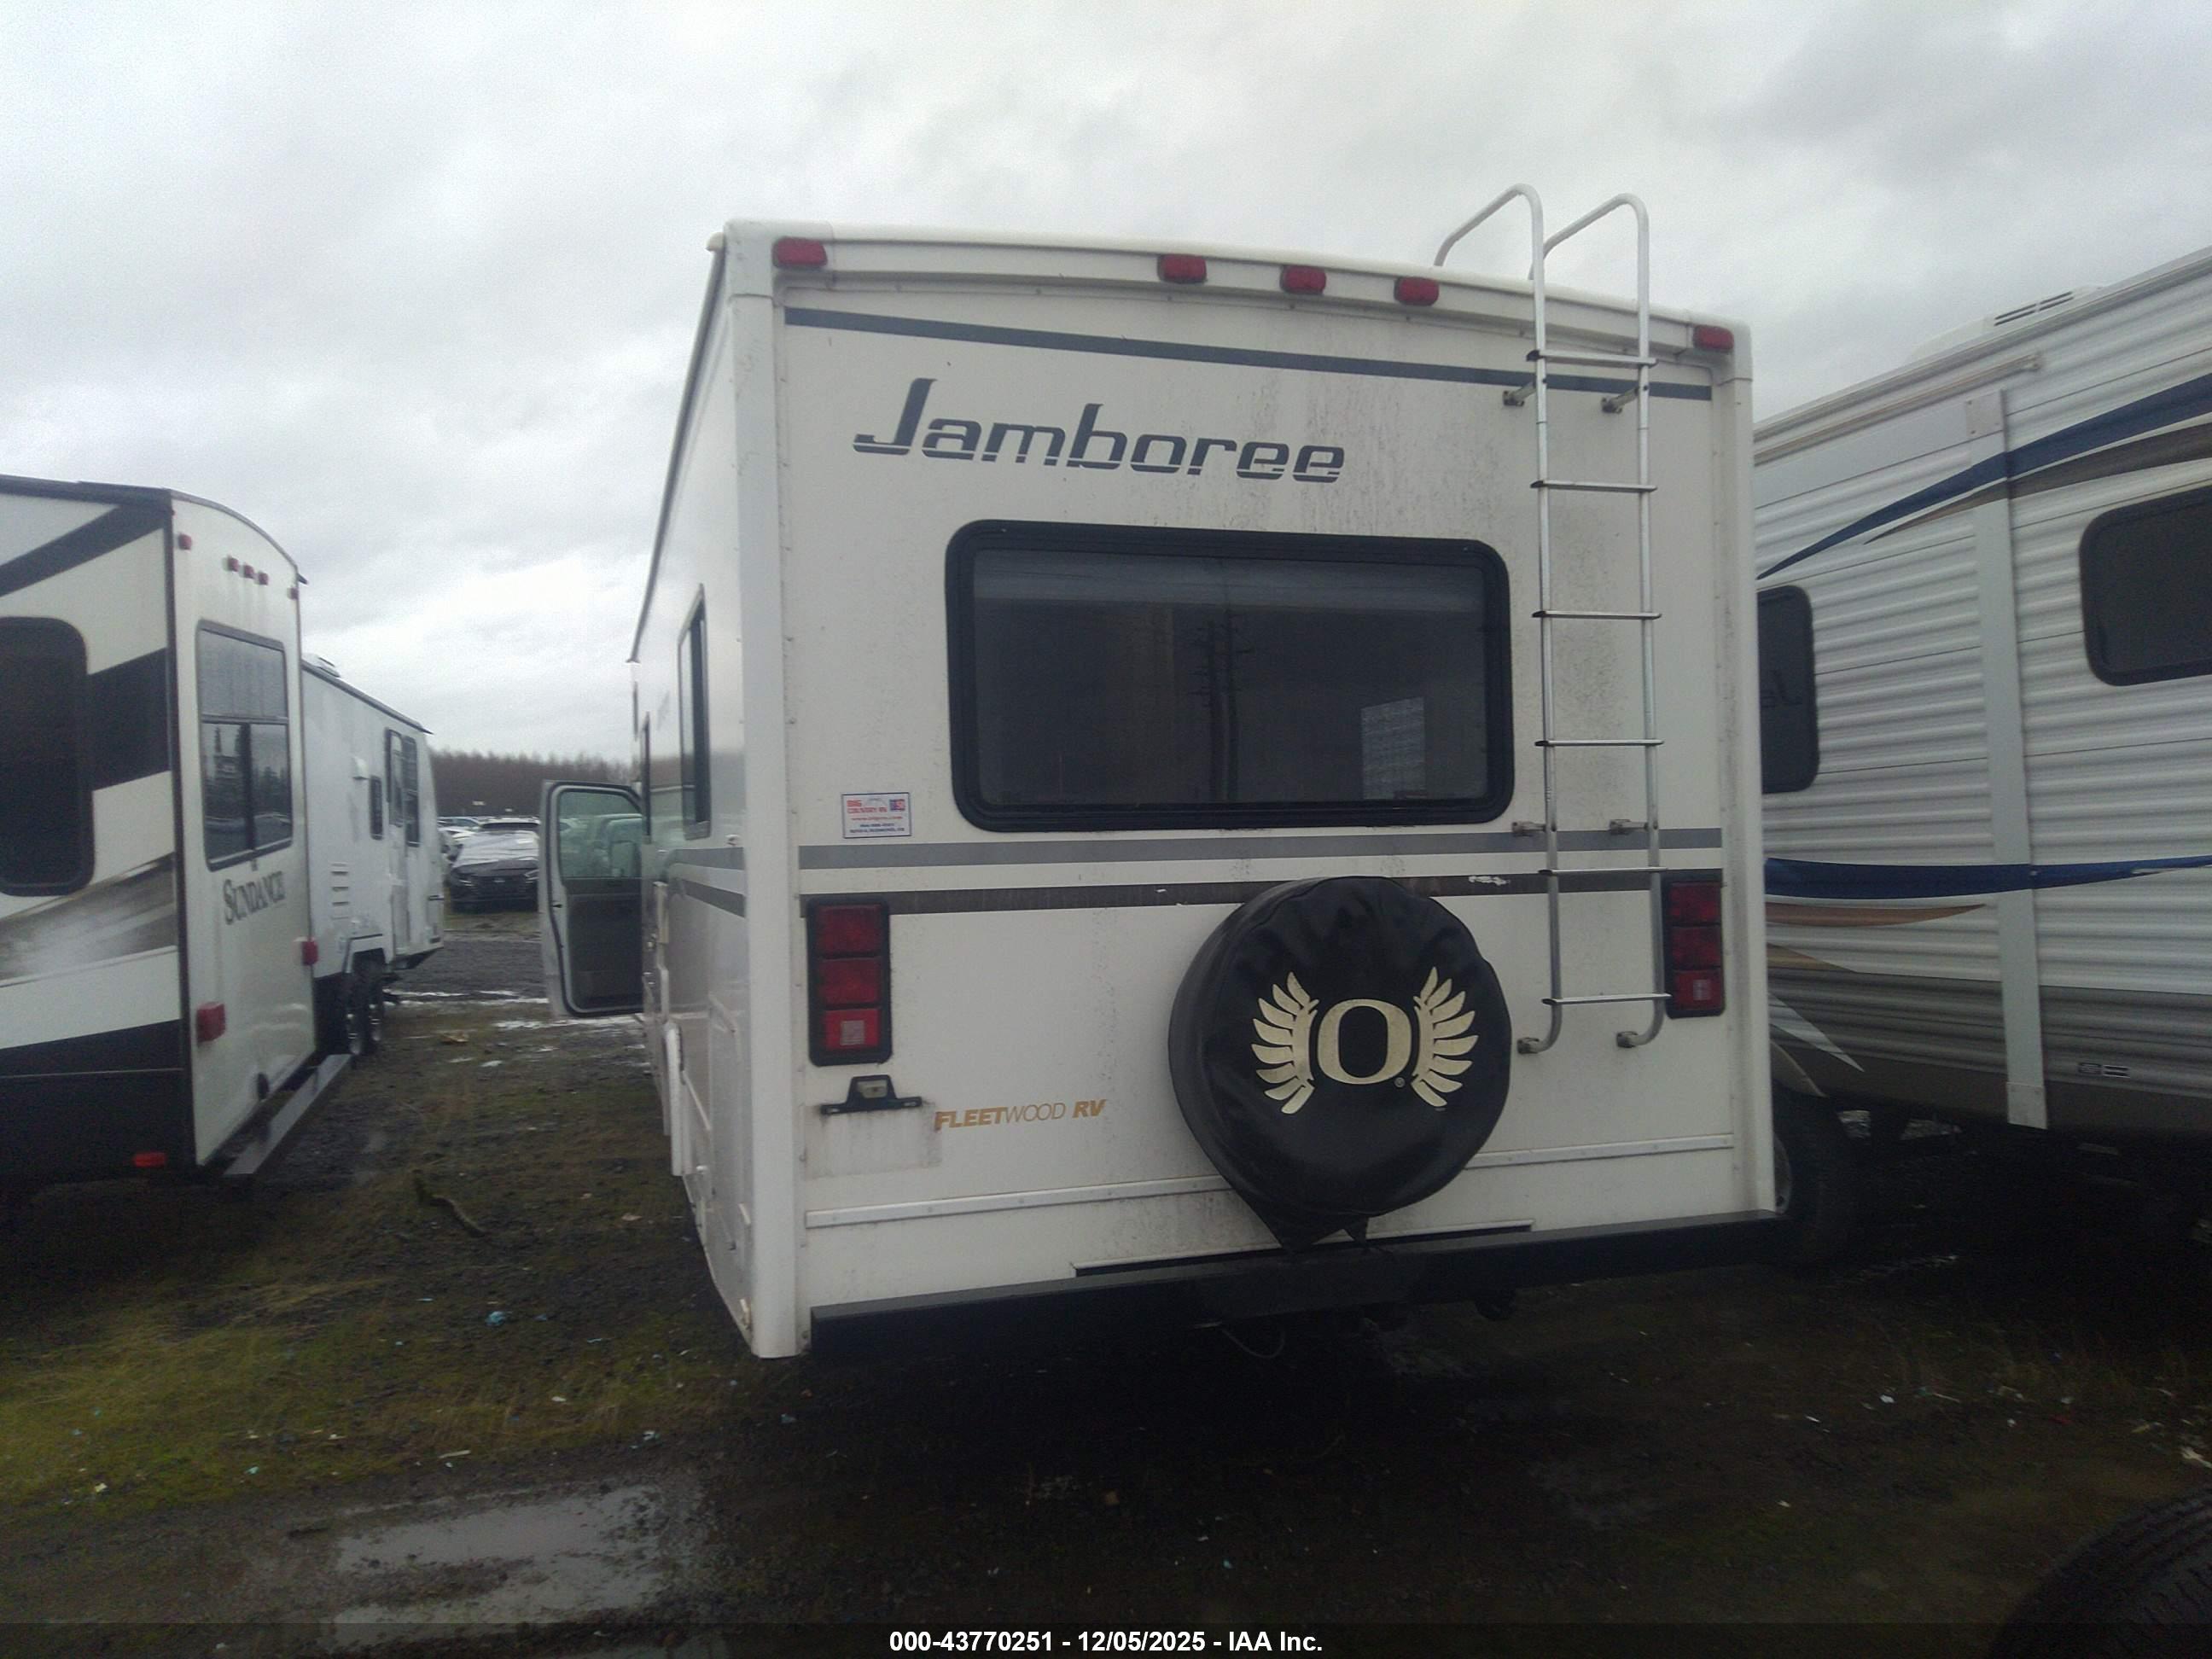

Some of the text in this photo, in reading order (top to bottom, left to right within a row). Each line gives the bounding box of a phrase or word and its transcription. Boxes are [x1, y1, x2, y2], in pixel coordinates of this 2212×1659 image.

[854, 378, 1345, 482] Jamboree
[222, 870, 286, 925] SUNDANCE
[1318, 998, 1412, 1085] O
[934, 1098, 1108, 1132] FLEETWOOD RV
